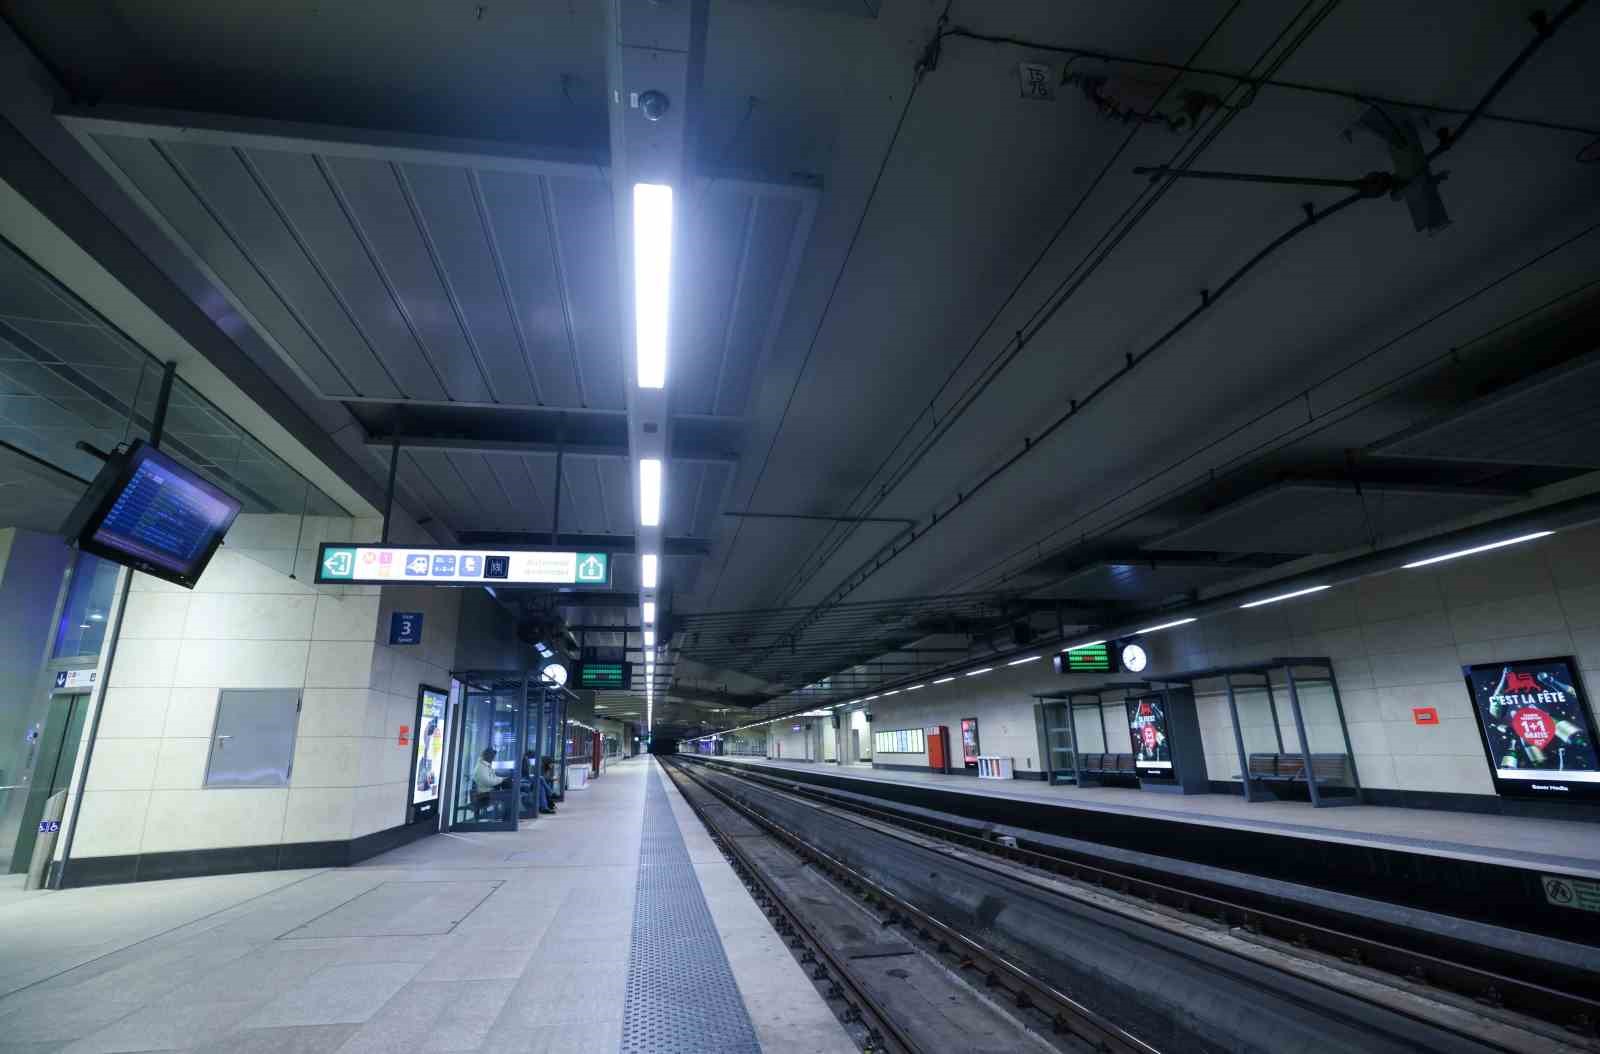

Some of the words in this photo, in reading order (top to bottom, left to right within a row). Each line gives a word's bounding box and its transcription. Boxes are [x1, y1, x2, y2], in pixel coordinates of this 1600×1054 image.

[401, 621, 411, 635] 3
[1521, 694, 1535, 704] LA
[1537, 690, 1566, 703] FÊTE
[1520, 719, 1546, 732] 1+1
